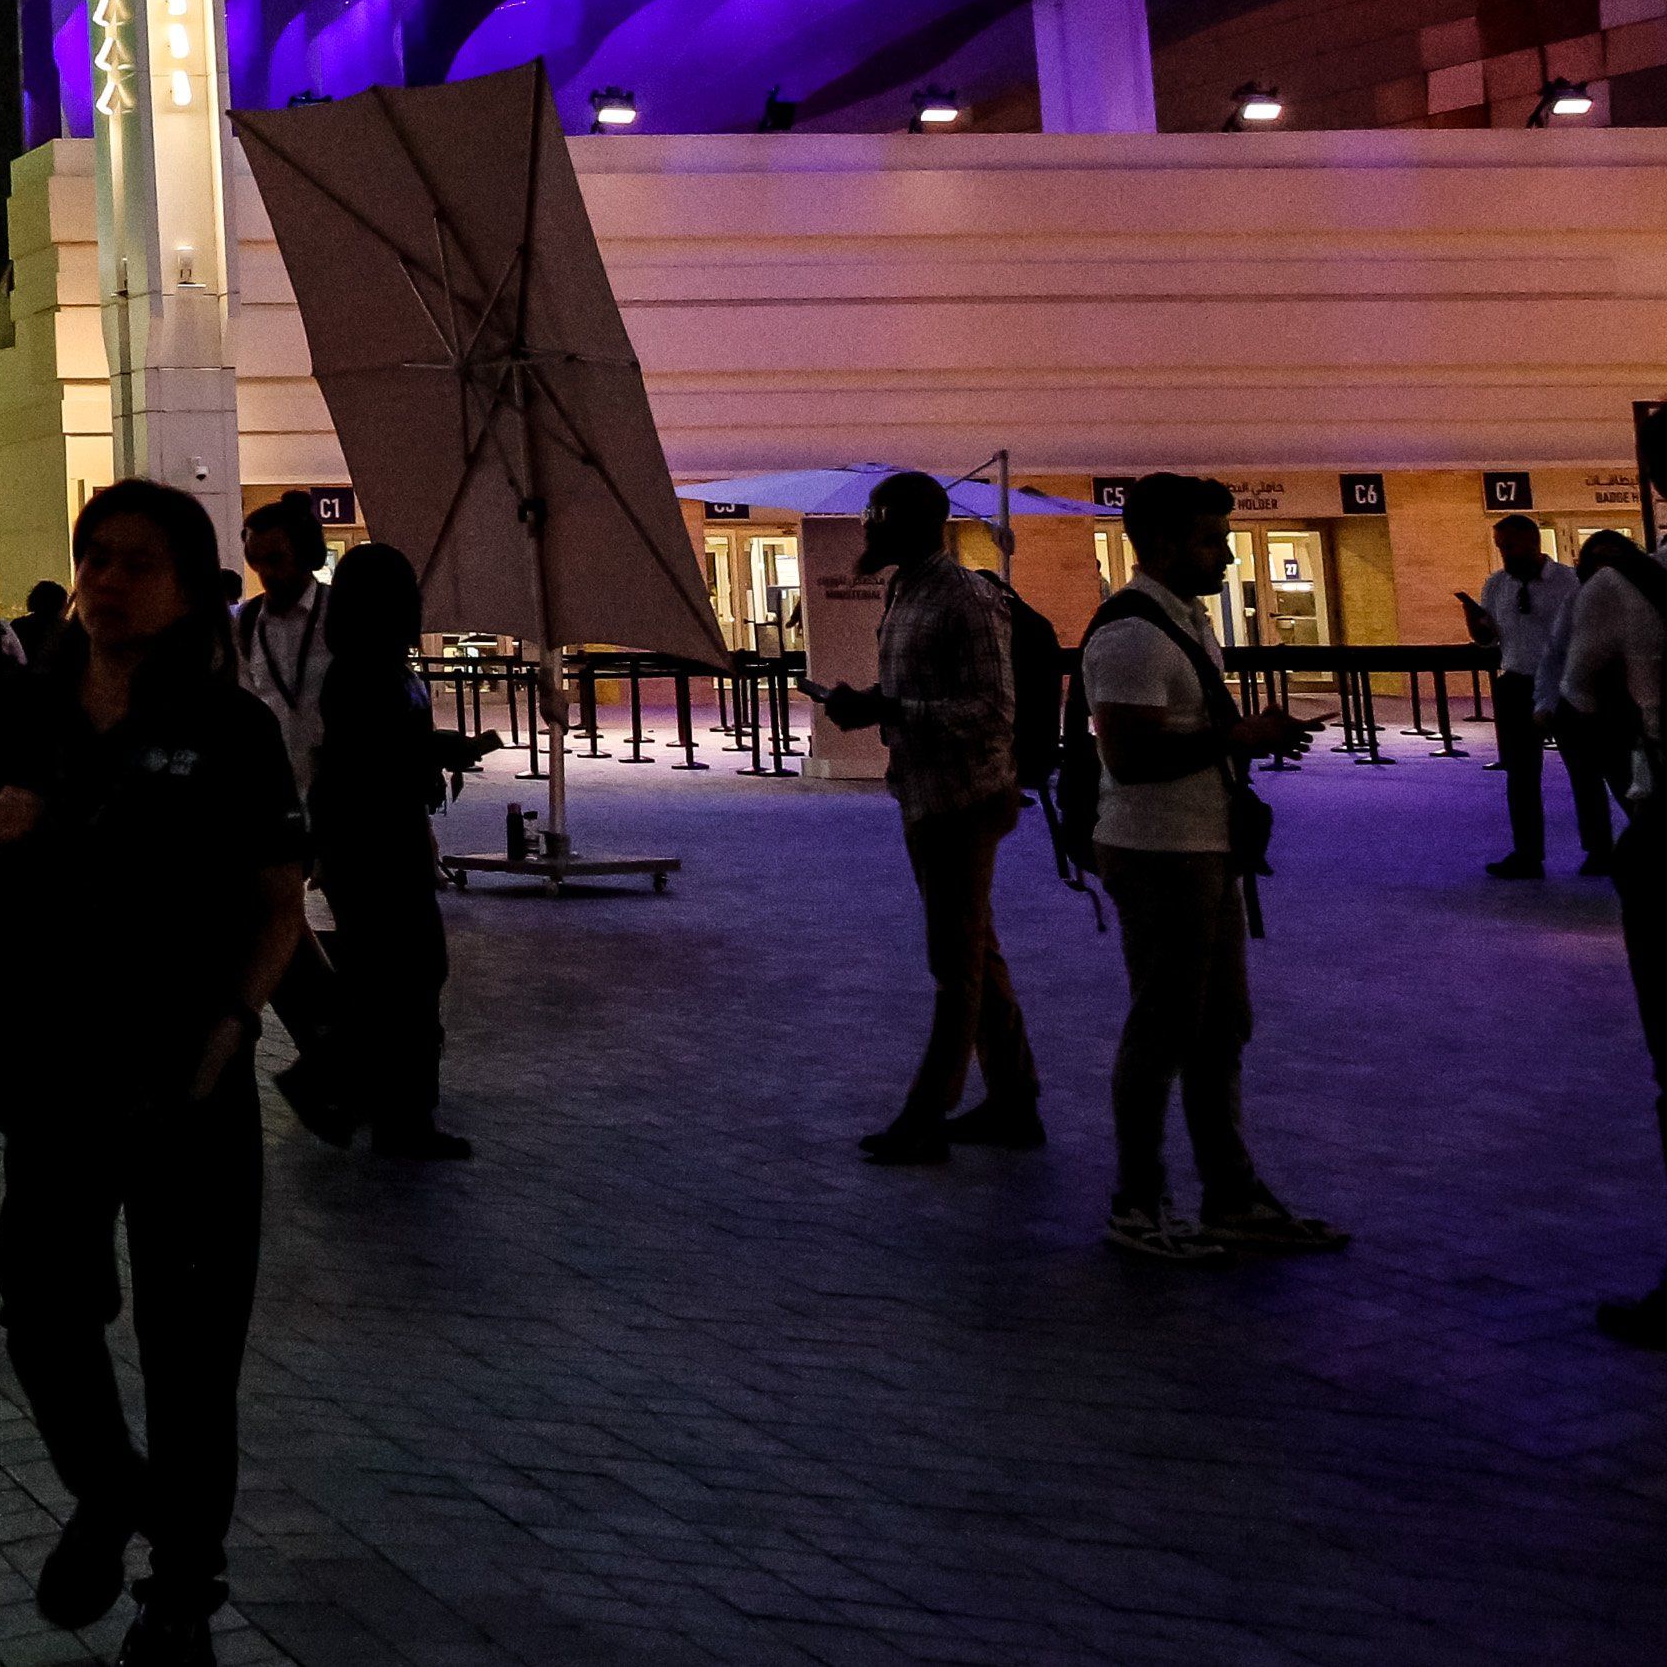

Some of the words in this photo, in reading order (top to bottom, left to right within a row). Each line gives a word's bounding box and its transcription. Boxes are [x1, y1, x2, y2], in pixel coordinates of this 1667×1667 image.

[1103, 487, 1125, 507] C5
[1354, 485, 1377, 503] C6
[1495, 481, 1516, 501] C7
[320, 498, 340, 518] C1
[1238, 498, 1279, 510] HOLDER
[1285, 562, 1298, 576] 27
